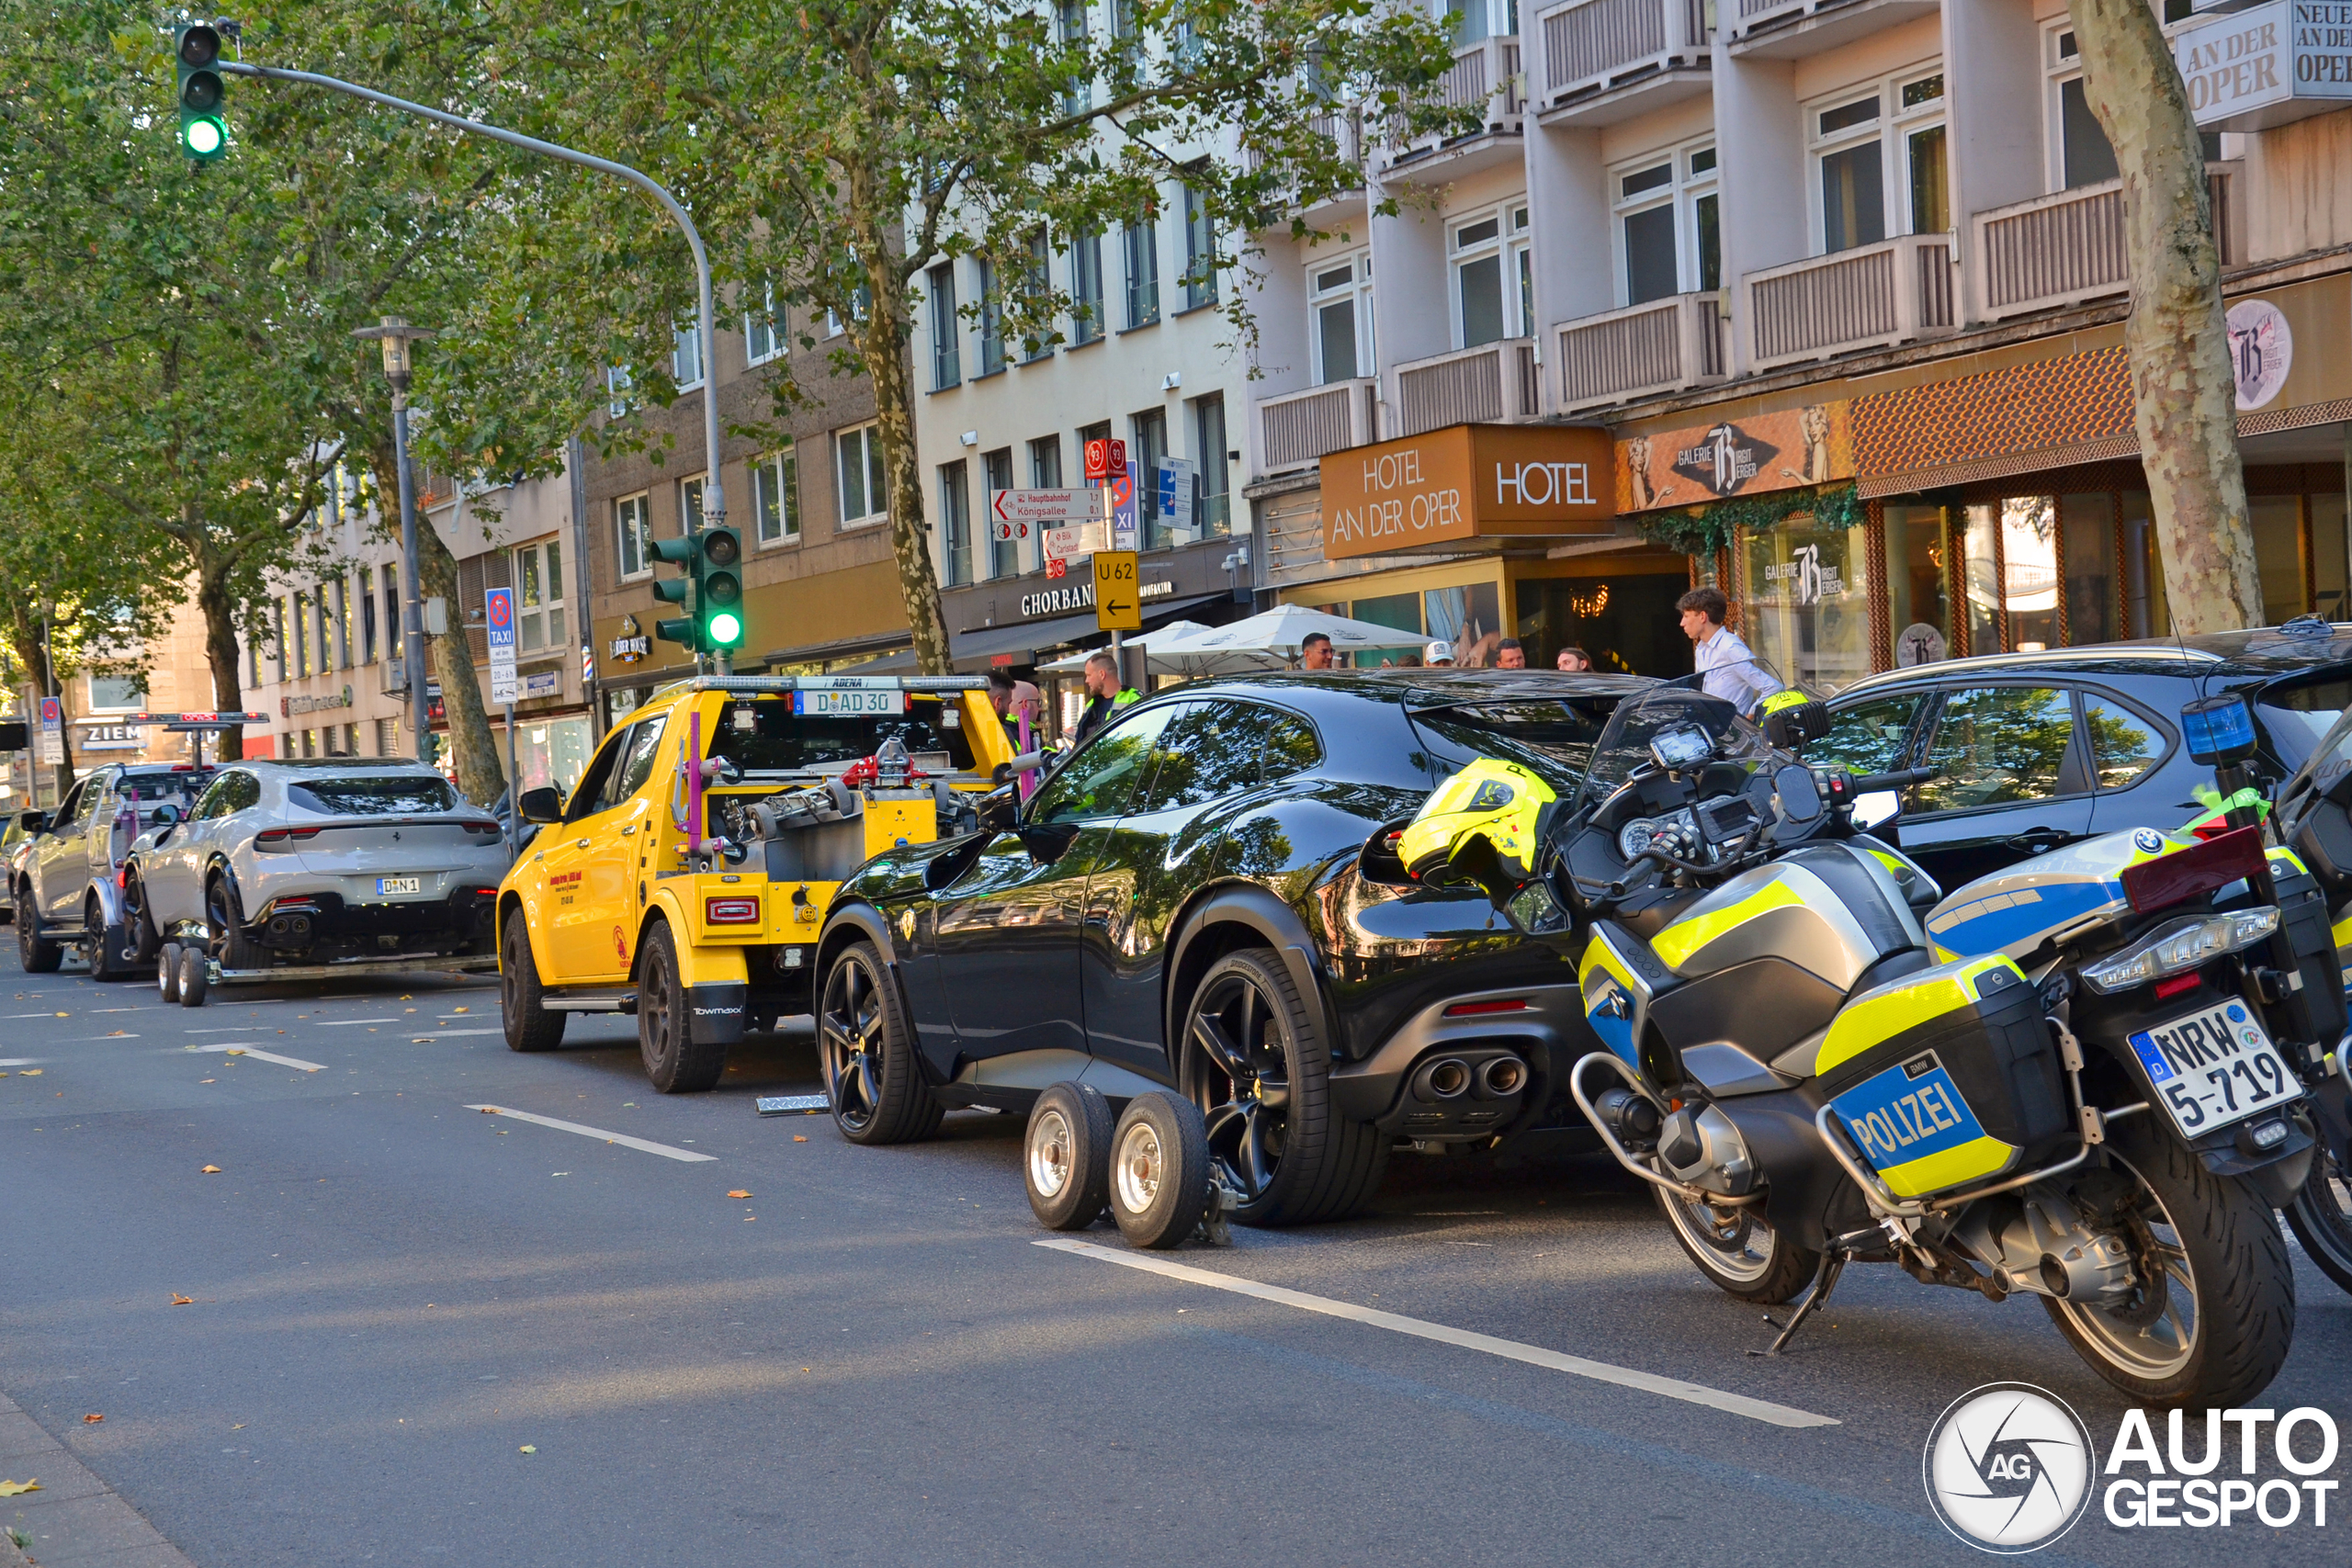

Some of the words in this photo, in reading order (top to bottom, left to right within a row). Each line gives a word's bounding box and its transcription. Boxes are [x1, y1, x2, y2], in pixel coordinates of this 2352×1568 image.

[2297, 28, 2323, 47] AN
[2326, 28, 2352, 47] DE
[2185, 40, 2221, 74] AN
[2225, 22, 2278, 62] DER
[2188, 52, 2280, 112] OPER
[1091, 449, 1100, 462] 93
[1114, 448, 1121, 460] 93
[1678, 446, 1713, 467] GALERIE
[1363, 448, 1426, 493] HOTEL
[1496, 462, 1597, 505] HOTEL
[1027, 492, 1071, 504] Hauptbahnhof
[1017, 507, 1067, 517] Königsallee
[1331, 506, 1365, 544] AN
[1370, 499, 1405, 537] DER
[1410, 488, 1463, 530] OPER
[1061, 532, 1072, 541] Bilk
[1056, 543, 1079, 554] Carlstadt
[1099, 563, 1110, 581] U
[1114, 562, 1133, 581] 62
[1765, 561, 1798, 581] GALERIE
[1138, 581, 1172, 597] ANUFAKTUR
[491, 630, 512, 644] TAXI
[831, 678, 862, 688] ADENA
[817, 694, 829, 712] D
[840, 694, 863, 712] AD
[867, 693, 888, 711] 30
[43, 721, 60, 730] TAXI
[86, 725, 142, 741] ZIEM
[693, 1005, 743, 1016] Towmaxx
[2154, 1012, 2240, 1076] NRW
[1909, 1059, 1929, 1074] BMW
[2152, 1062, 2165, 1077] D
[2164, 1052, 2285, 1128] 5-719
[1849, 1081, 1963, 1159] POLIZEI
